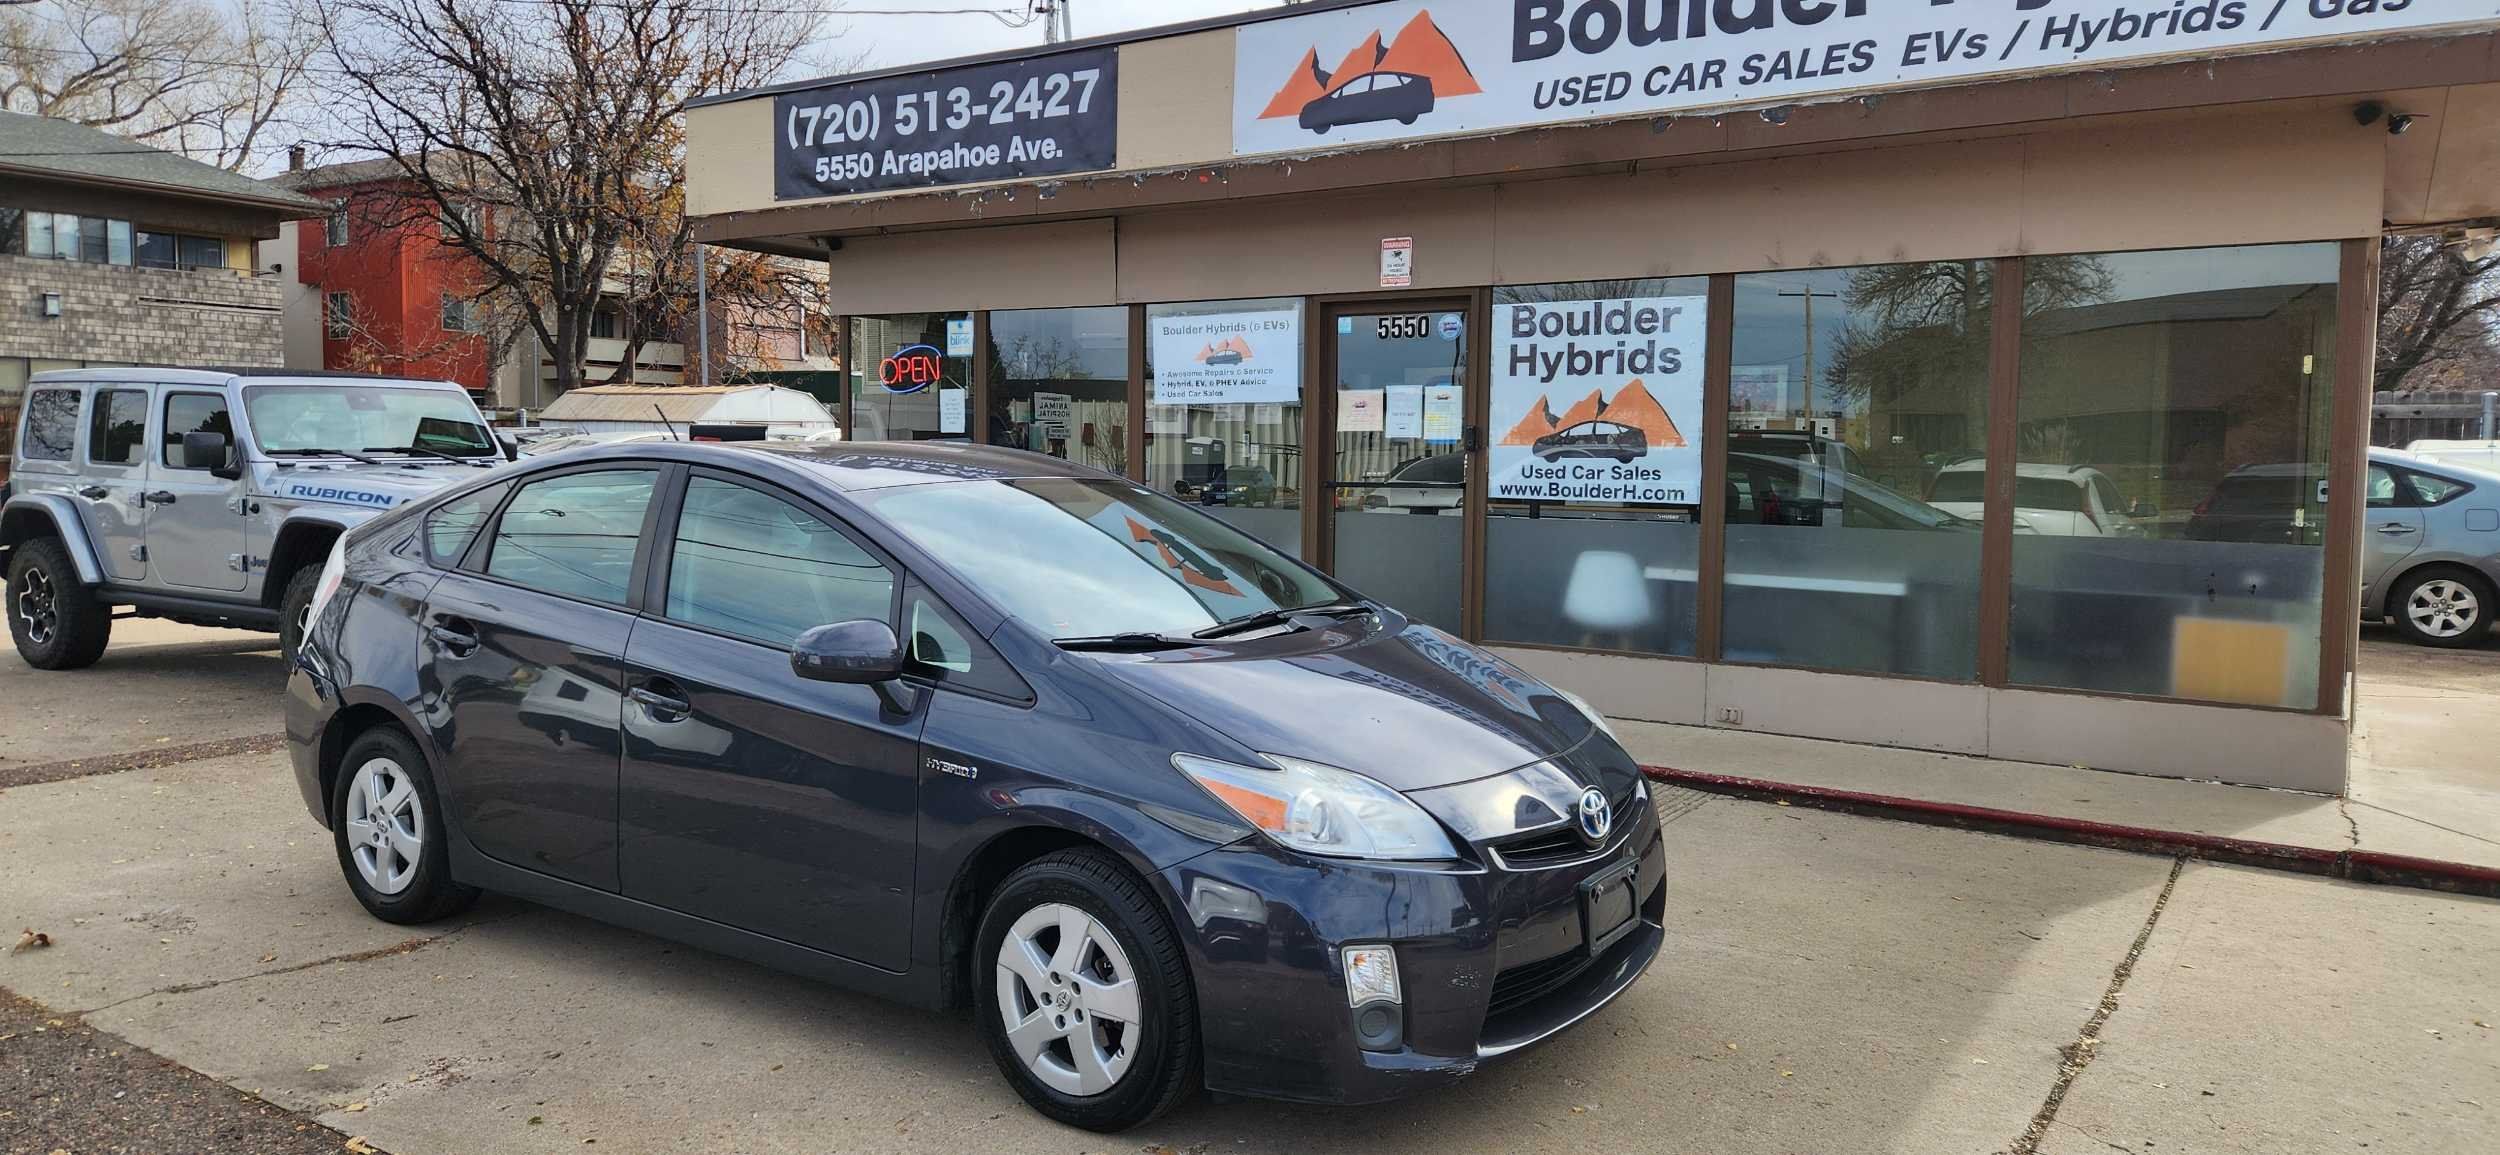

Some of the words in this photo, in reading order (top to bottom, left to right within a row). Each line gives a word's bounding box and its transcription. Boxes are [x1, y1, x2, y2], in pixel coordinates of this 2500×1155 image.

[1533, 71, 1631, 110] USED
[1643, 59, 1727, 96] CAR
[1738, 39, 1877, 86] SALES
[1901, 28, 1990, 67] EVs
[2040, 0, 2247, 53] Hybrids
[787, 94, 880, 149] (720)
[894, 69, 1100, 136] 513-2427
[815, 156, 874, 183] 5550
[881, 143, 1000, 177] Arapahoe
[1007, 135, 1063, 163] Ave.
[1163, 325, 1203, 336] Boulder
[1206, 322, 1246, 334] Hybrids
[1377, 315, 1430, 339] 5550
[1512, 300, 1682, 338] Boulder
[879, 356, 941, 385] OPEN
[1509, 340, 1682, 383] Hybrids
[1216, 378, 1238, 386] PHEV
[1188, 390, 1201, 398] Car
[1522, 465, 1566, 480] Used
[1572, 465, 1605, 480] Car
[1611, 466, 1662, 481] Sales
[291, 485, 393, 505] RUBICON
[1500, 482, 1685, 501] www.BoulderH.com
[925, 757, 971, 778] HYBRID
